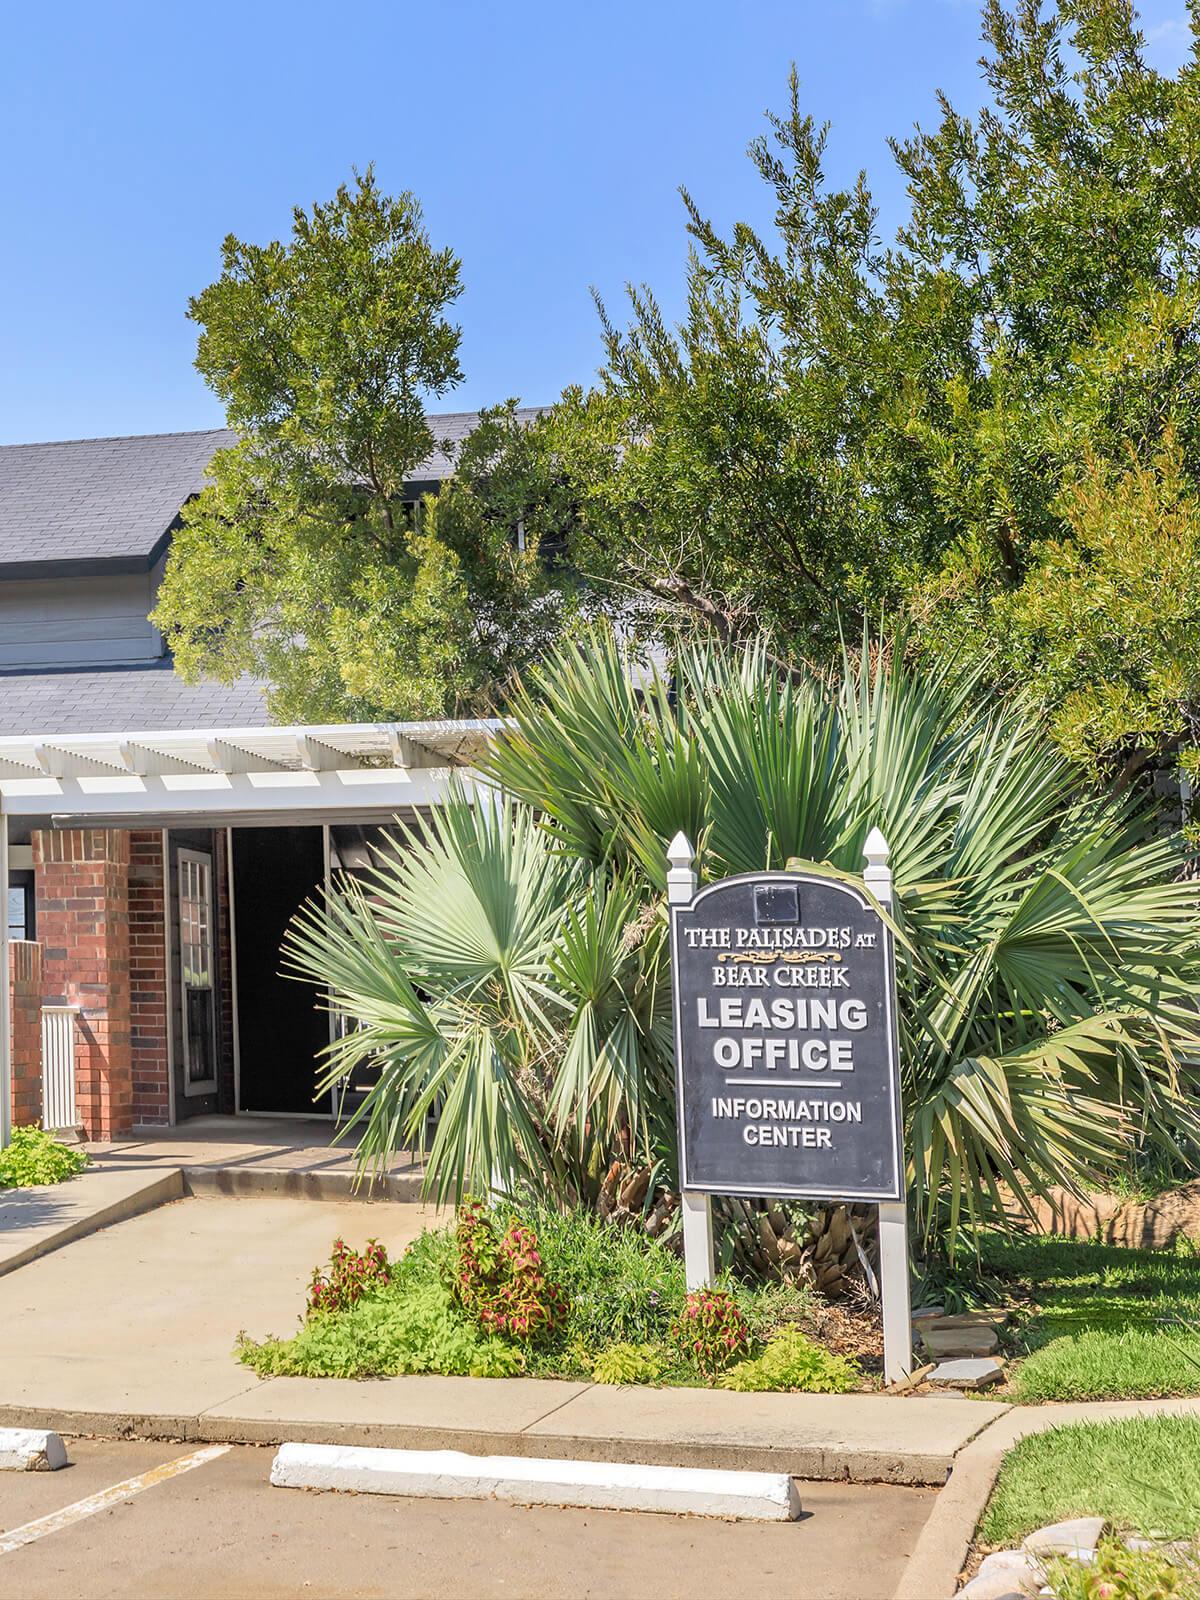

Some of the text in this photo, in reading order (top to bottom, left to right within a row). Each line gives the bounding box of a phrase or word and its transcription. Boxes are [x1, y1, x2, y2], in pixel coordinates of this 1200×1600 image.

[684, 926, 877, 949] THE PALISADES AT
[712, 966, 850, 988] BEAR CREEK
[697, 998, 868, 1030] LEASING
[713, 1038, 854, 1071] OFFICE
[712, 1098, 862, 1122] INFORMATION
[743, 1126, 833, 1148] CENTER
